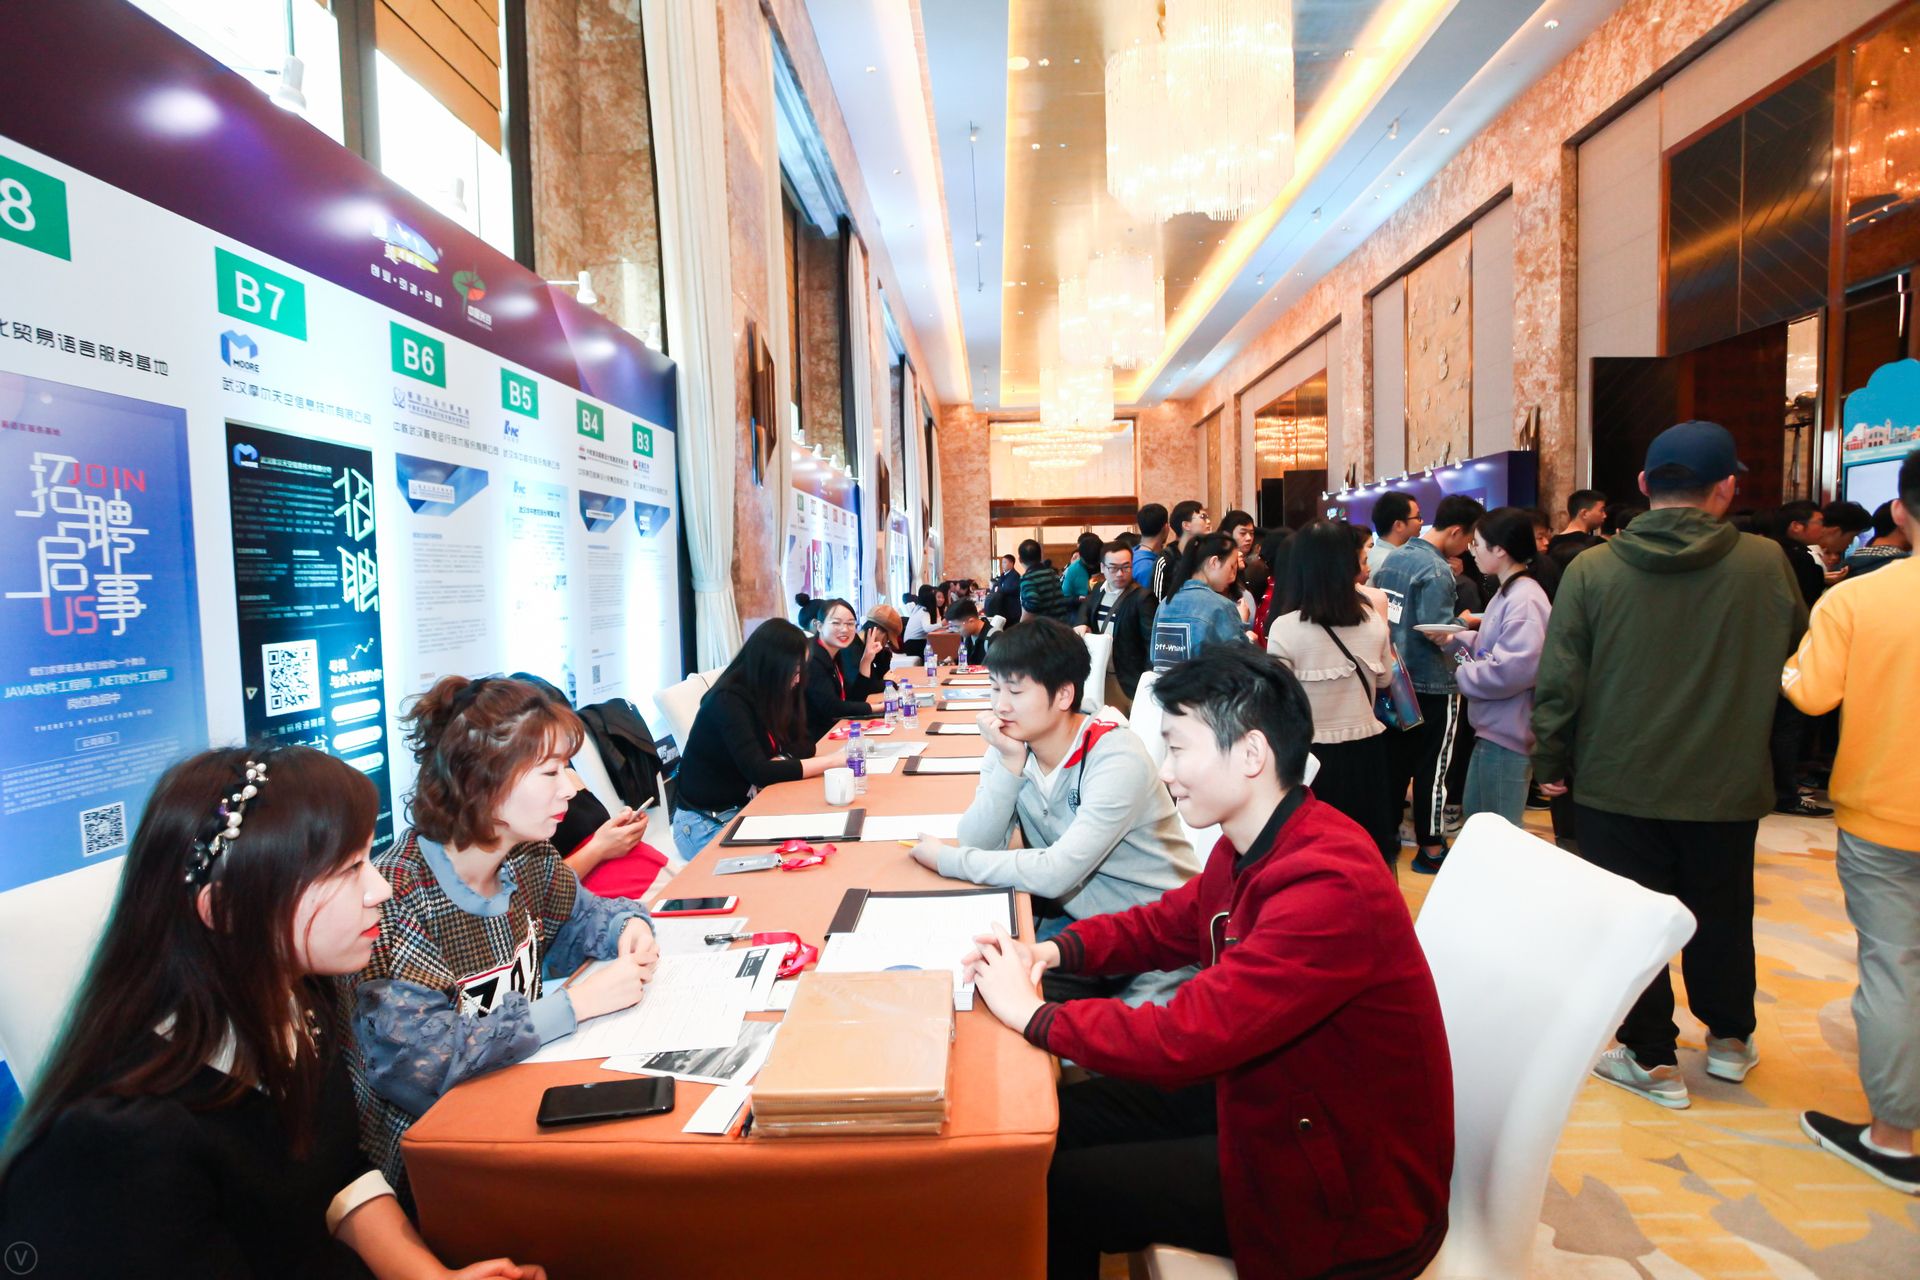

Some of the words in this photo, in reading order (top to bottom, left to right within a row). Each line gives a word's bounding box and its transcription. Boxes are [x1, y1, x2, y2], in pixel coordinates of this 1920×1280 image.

[235, 270, 286, 322] B7
[232, 358, 260, 374] MOORE
[403, 338, 436, 377] B6
[509, 380, 532, 411] B5
[582, 408, 599, 435] B4
[636, 430, 650, 453] B3
[67, 463, 147, 493] JOIN
[42, 595, 99, 637] US
